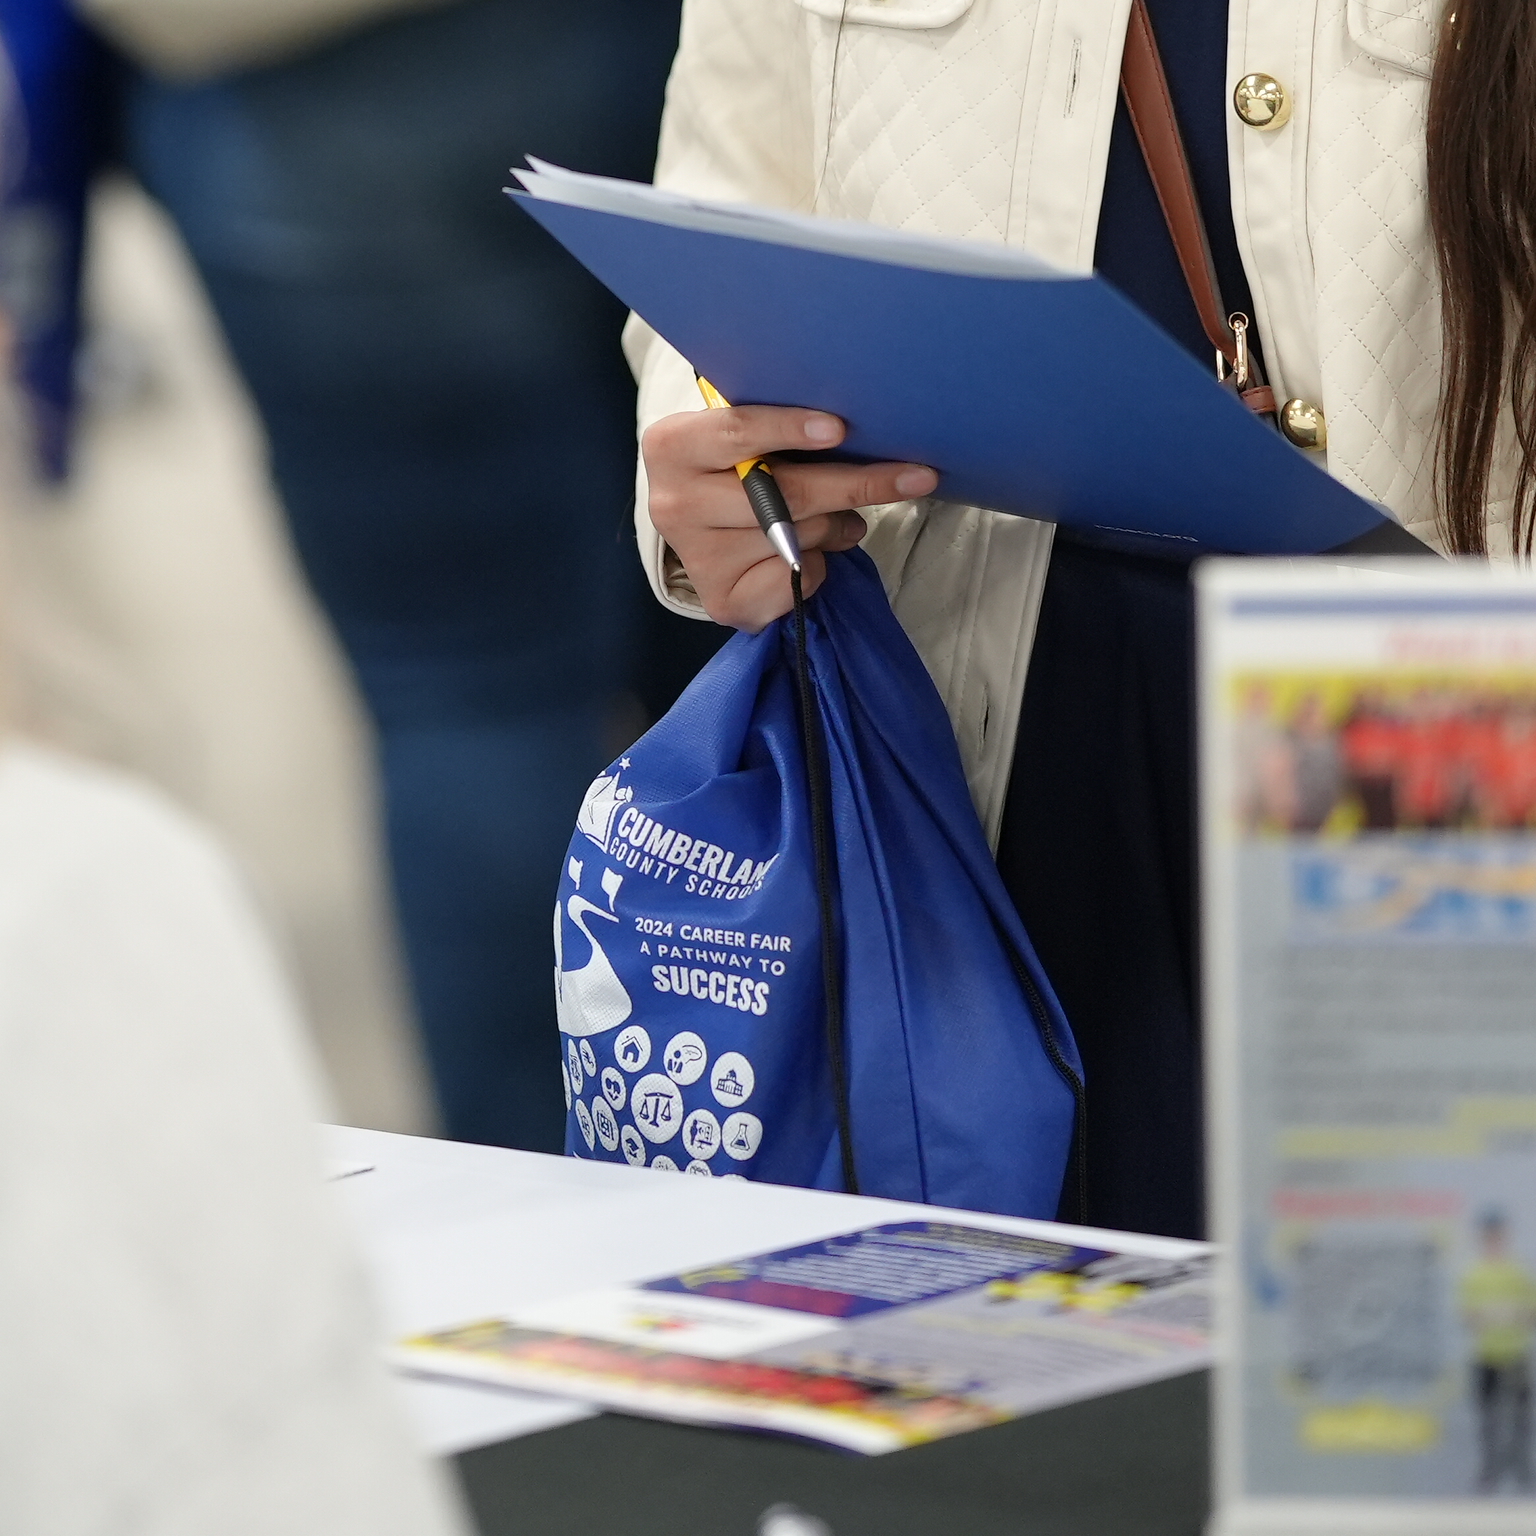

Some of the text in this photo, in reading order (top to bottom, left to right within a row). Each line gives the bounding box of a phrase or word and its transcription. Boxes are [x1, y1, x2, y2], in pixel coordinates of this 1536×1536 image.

[609, 836, 679, 885] COUNTY
[617, 807, 780, 887] CUMBERLAN
[635, 917, 792, 953] 2024 CAREER FAIR
[640, 940, 786, 977] A PATHWAY TO
[651, 964, 770, 1017] SUCCESS
